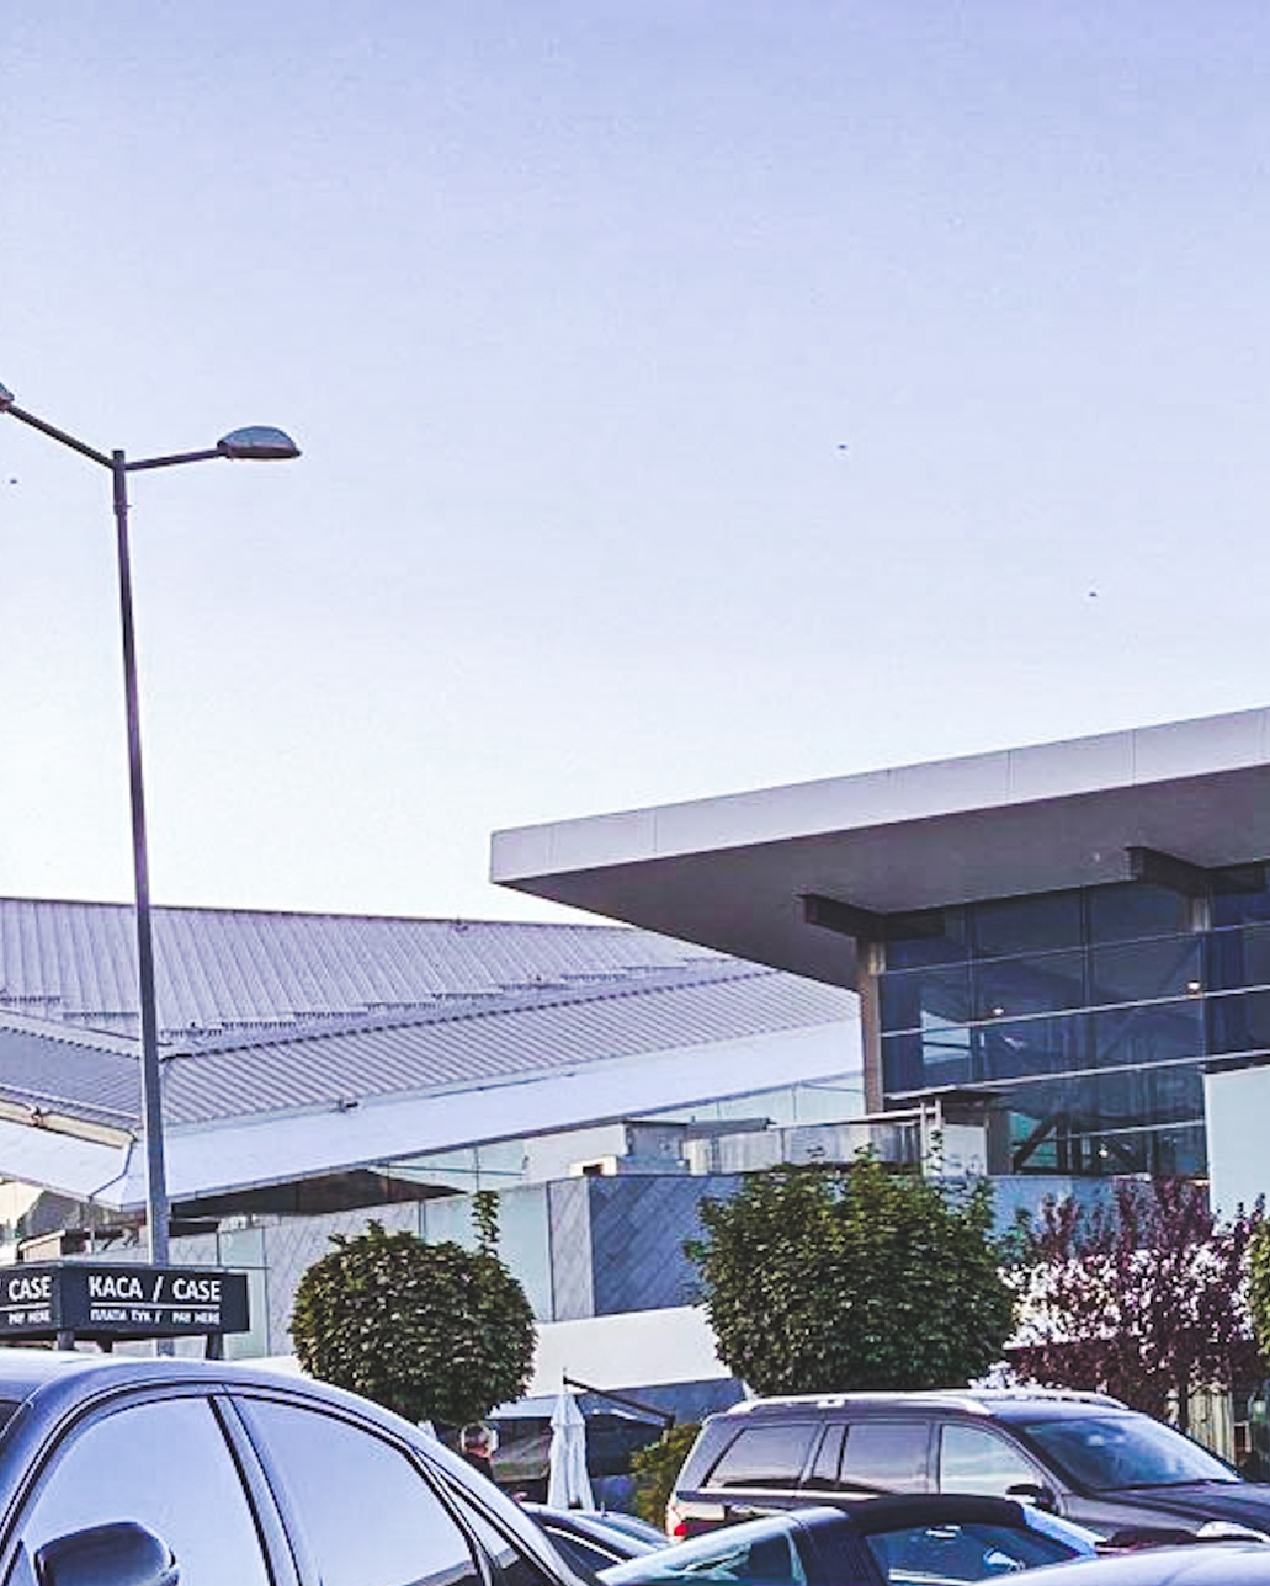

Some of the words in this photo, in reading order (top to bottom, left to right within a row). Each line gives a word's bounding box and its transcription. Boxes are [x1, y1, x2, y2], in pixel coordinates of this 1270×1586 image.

[9, 1275, 52, 1302] CASE
[88, 1275, 143, 1299] КАСА
[152, 1275, 165, 1303] /
[172, 1277, 222, 1302] CASE
